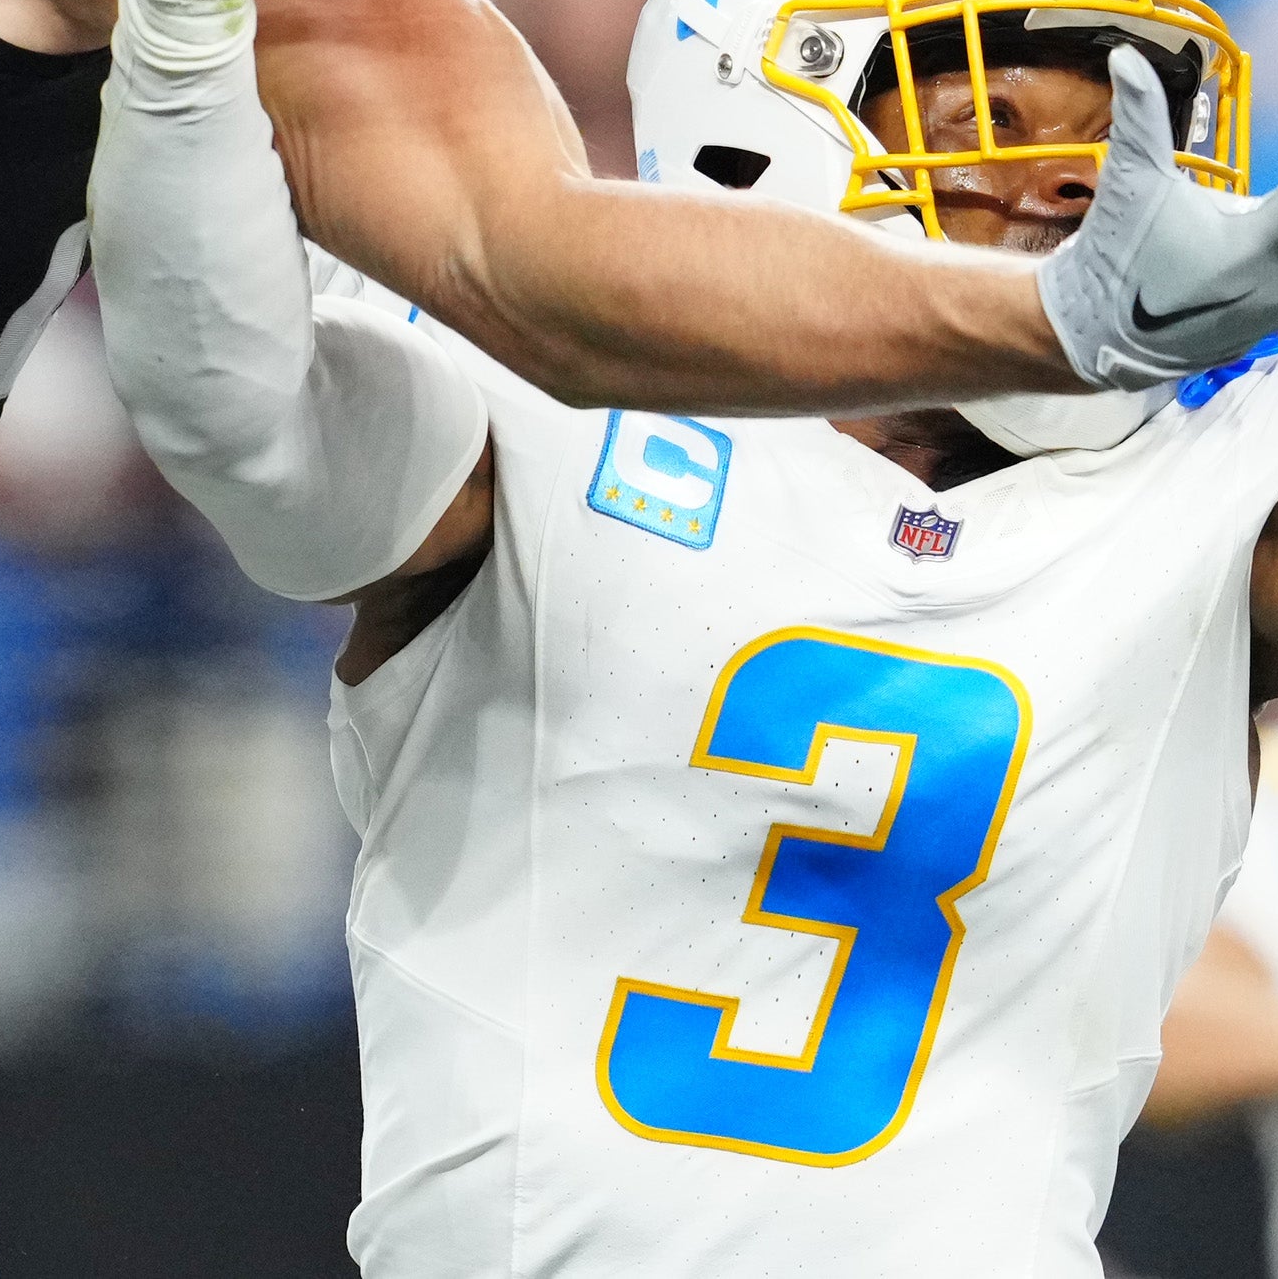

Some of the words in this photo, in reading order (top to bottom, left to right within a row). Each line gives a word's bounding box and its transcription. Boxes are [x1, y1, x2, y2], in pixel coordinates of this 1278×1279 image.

[613, 409, 720, 511] C
[899, 525, 944, 553] NFL
[595, 625, 1033, 1168] 3
